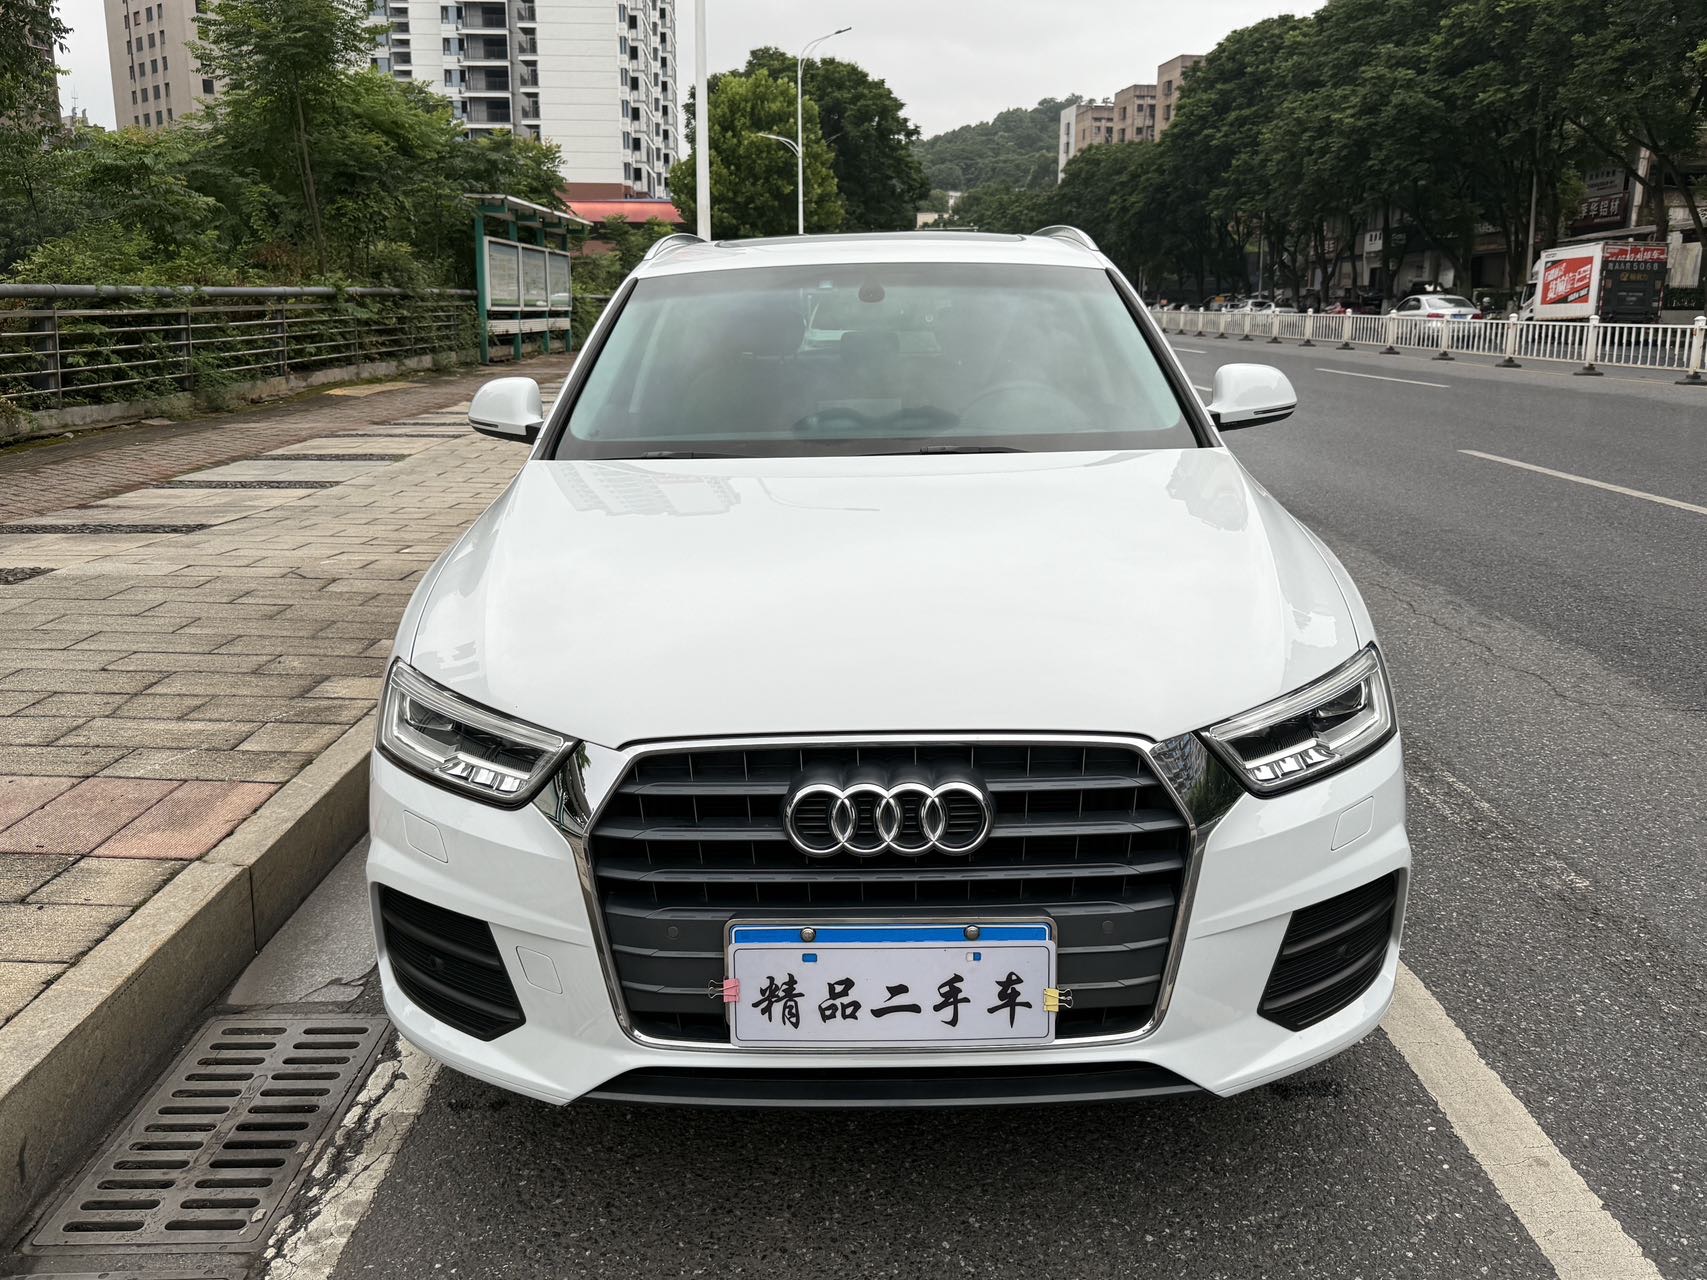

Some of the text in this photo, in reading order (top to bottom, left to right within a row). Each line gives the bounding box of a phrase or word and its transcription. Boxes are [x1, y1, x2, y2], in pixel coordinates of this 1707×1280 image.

[752, 971, 1033, 1029] 精品二手车
